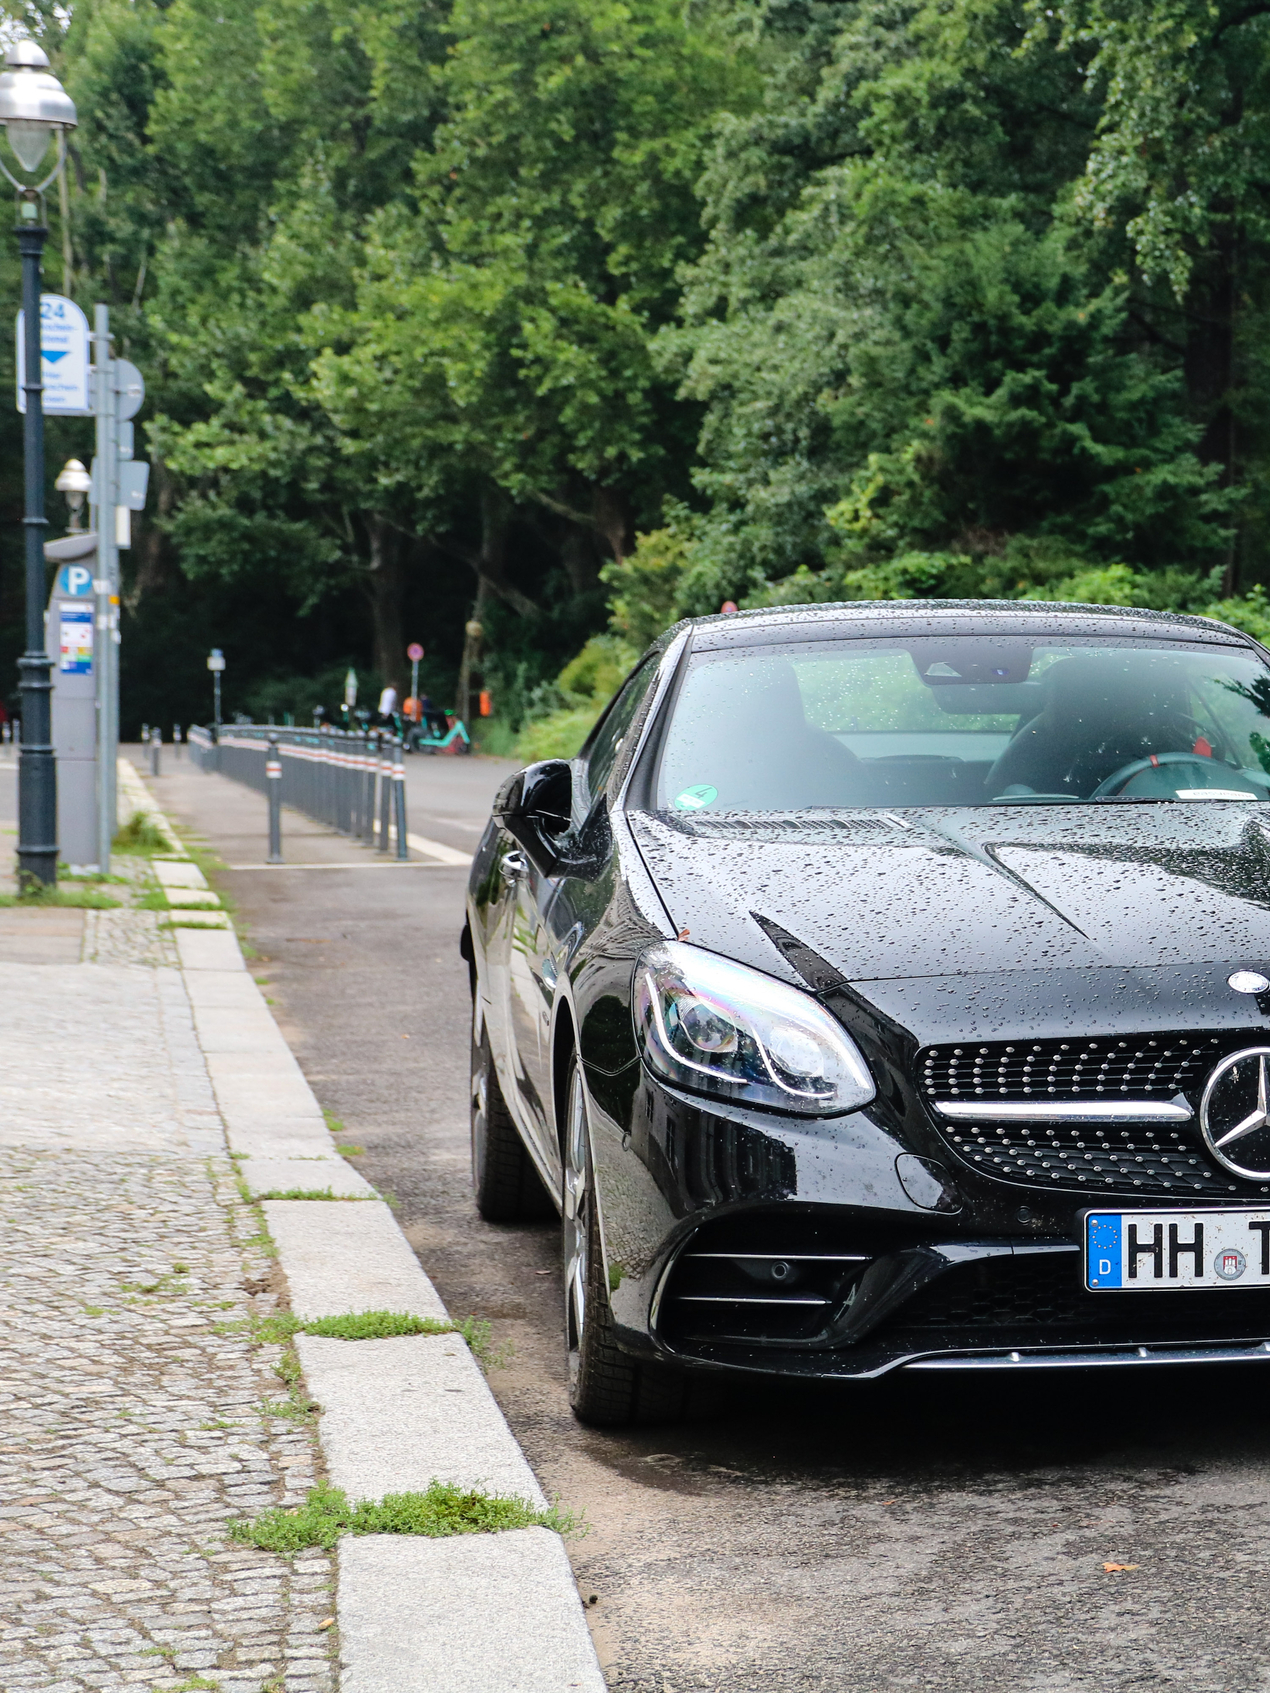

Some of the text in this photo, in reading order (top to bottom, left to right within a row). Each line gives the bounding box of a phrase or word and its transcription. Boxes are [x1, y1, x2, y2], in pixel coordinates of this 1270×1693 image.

[68, 566, 91, 595] P
[695, 787, 712, 798] 4
[1128, 1223, 1204, 1278] HH
[1099, 1260, 1111, 1275] D
